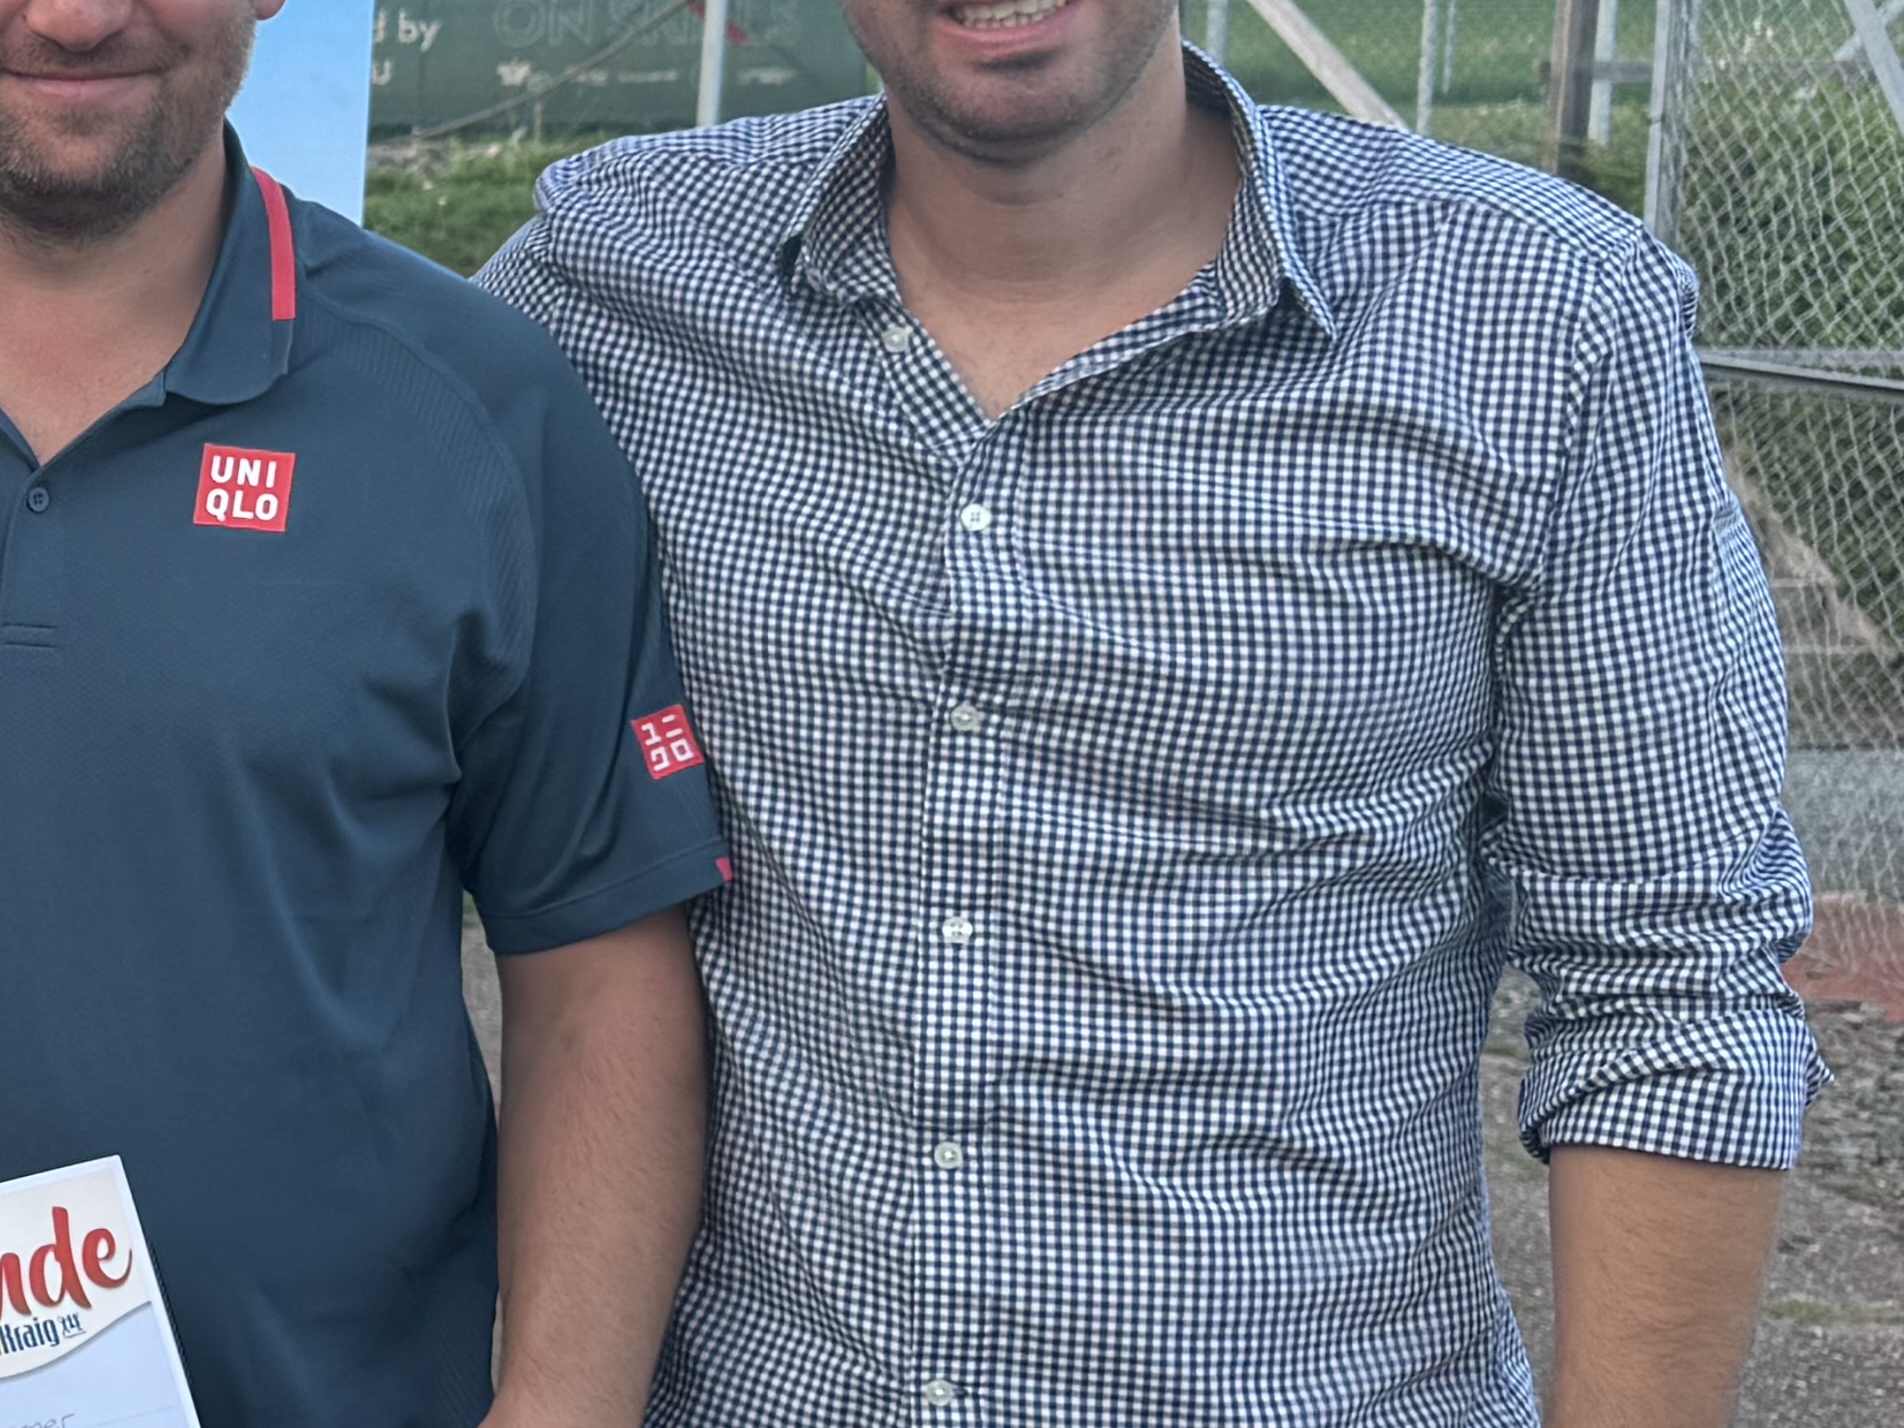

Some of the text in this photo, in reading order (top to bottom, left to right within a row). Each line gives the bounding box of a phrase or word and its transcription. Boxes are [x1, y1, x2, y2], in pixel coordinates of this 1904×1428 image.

[397, 6, 442, 53] by
[210, 455, 277, 488] UNI
[205, 488, 279, 521] QLO
